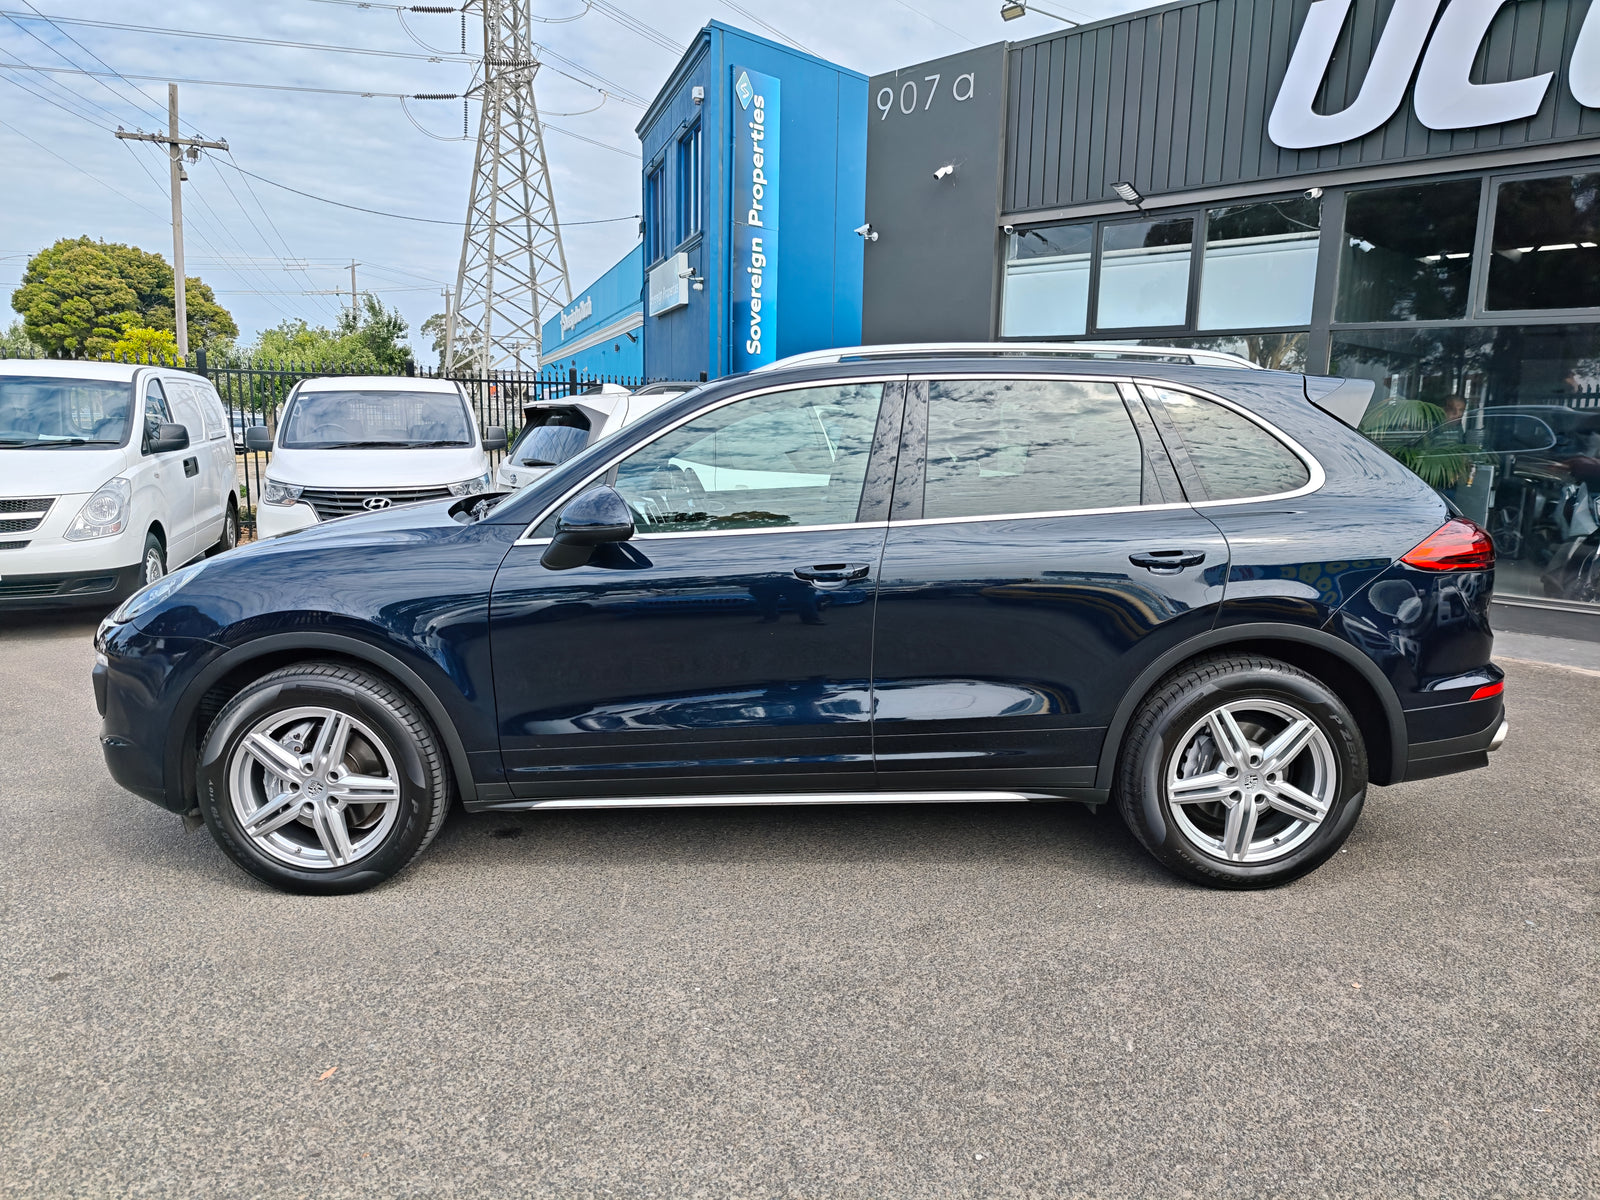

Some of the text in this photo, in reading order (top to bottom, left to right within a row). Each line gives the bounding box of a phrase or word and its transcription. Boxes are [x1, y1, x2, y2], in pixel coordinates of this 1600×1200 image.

[876, 72, 975, 121] 907 a
[746, 94, 766, 355] Sovereign Properties
